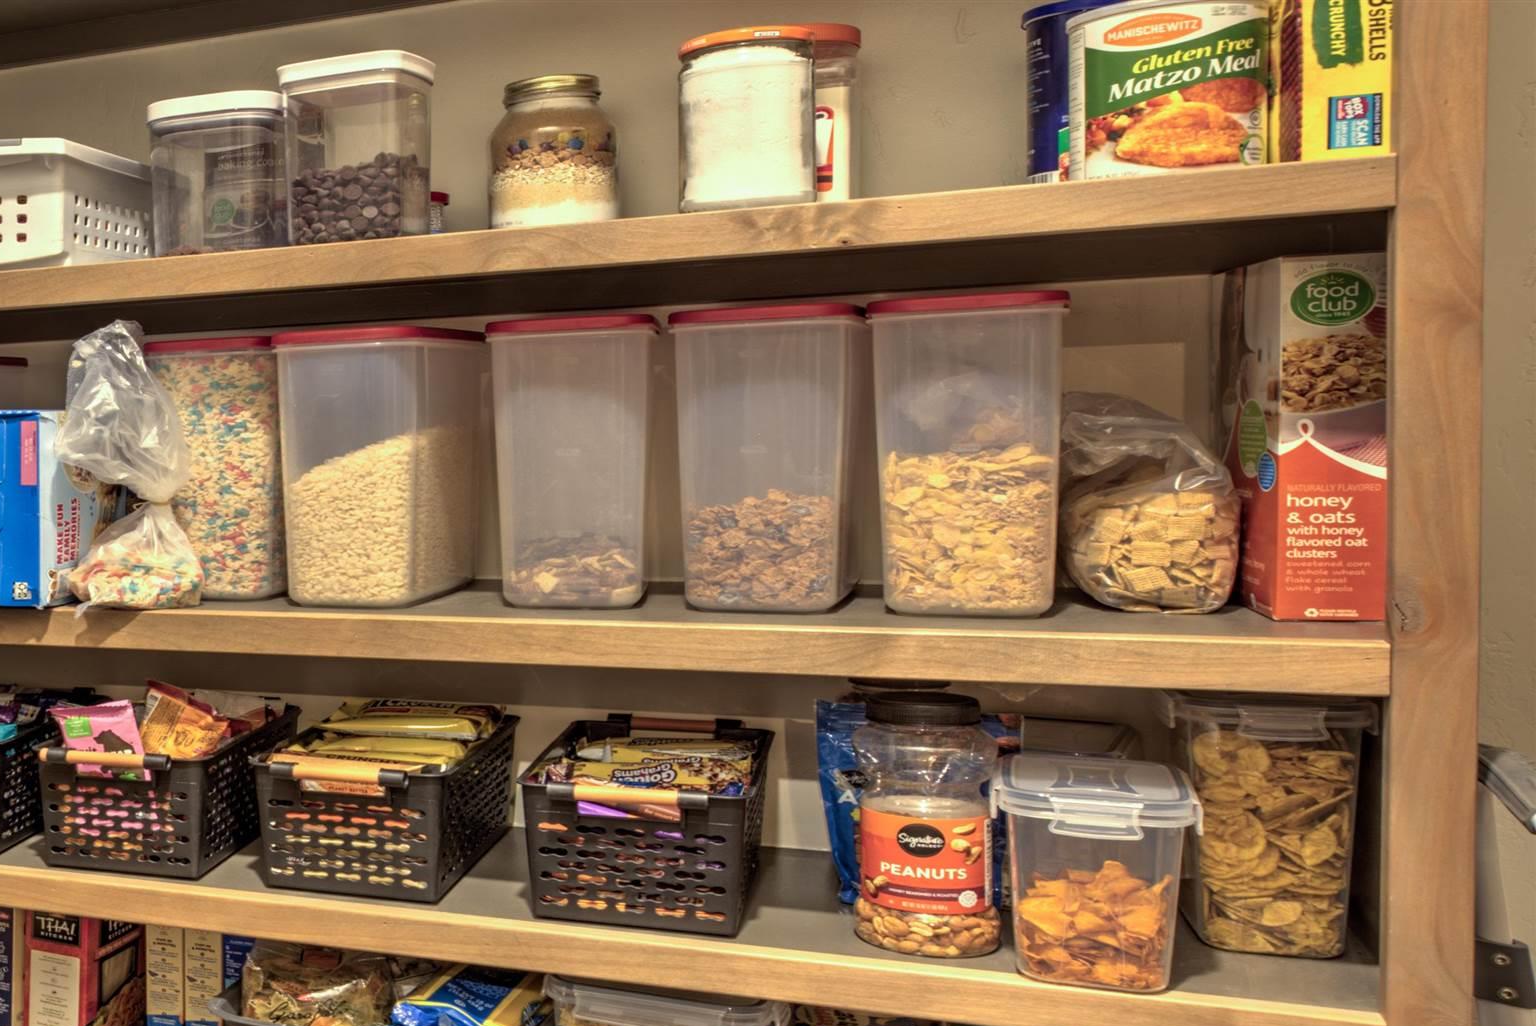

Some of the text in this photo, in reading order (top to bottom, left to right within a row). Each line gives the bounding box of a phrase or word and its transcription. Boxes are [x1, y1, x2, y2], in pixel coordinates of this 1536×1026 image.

[1107, 17, 1200, 43] MANISCHEWITZ
[1368, 8, 1386, 62] SHELLS
[1132, 37, 1254, 75] Gluten Free
[1107, 49, 1261, 103] Matzo Meal
[1305, 281, 1360, 298] food
[1307, 297, 1357, 312] club
[1286, 483, 1382, 492] NATURALLY FLAVORED
[1286, 493, 1353, 510] honey
[1286, 511, 1356, 523] & oats
[1286, 525, 1364, 537] with honey
[56, 531, 64, 565] MAKE
[1286, 536, 1368, 546] flavored oat
[1286, 548, 1337, 558] clusters
[898, 833, 944, 848] Signature
[880, 861, 967, 880] PEANUTS
[36, 916, 76, 936] THAI
